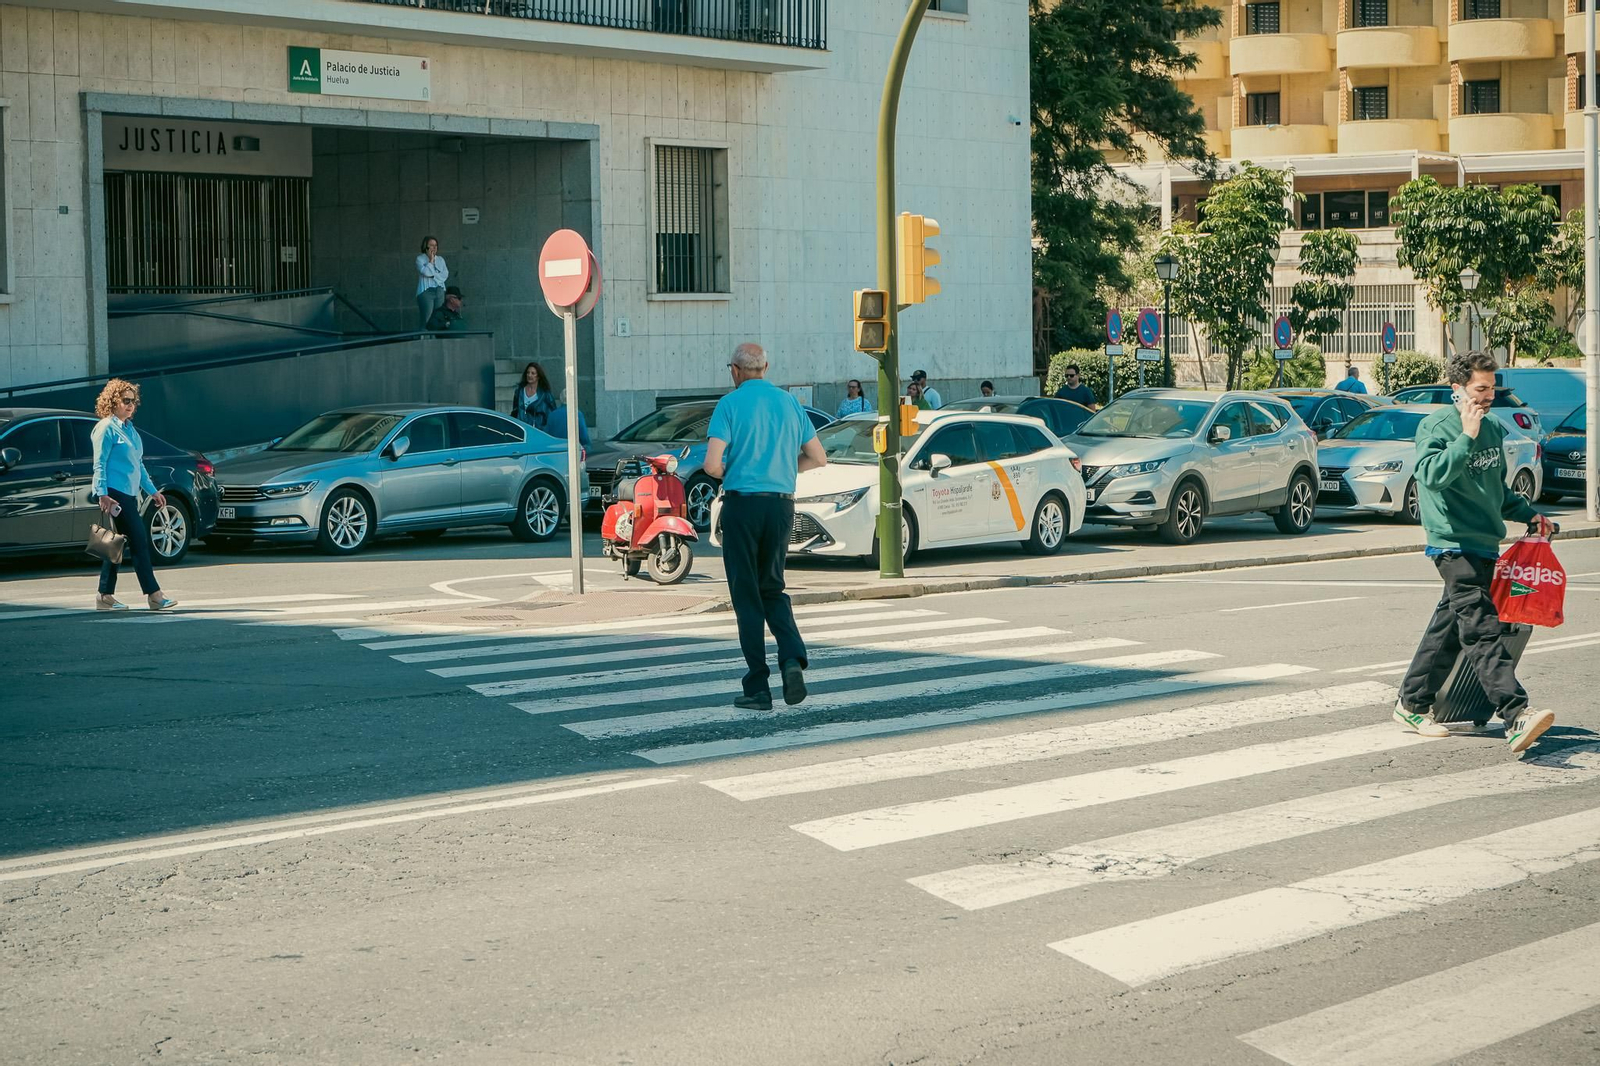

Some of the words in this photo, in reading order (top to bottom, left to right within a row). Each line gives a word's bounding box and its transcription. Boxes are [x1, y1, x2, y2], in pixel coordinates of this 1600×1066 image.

[326, 62, 356, 73] Palacio
[358, 64, 368, 74] de
[370, 65, 400, 76] Justicia
[326, 75, 350, 84] Huelva
[118, 126, 227, 155] JUSTICIA
[932, 488, 950, 498] Toyota
[220, 508, 234, 518] KFH
[1493, 561, 1564, 586] rebajas
